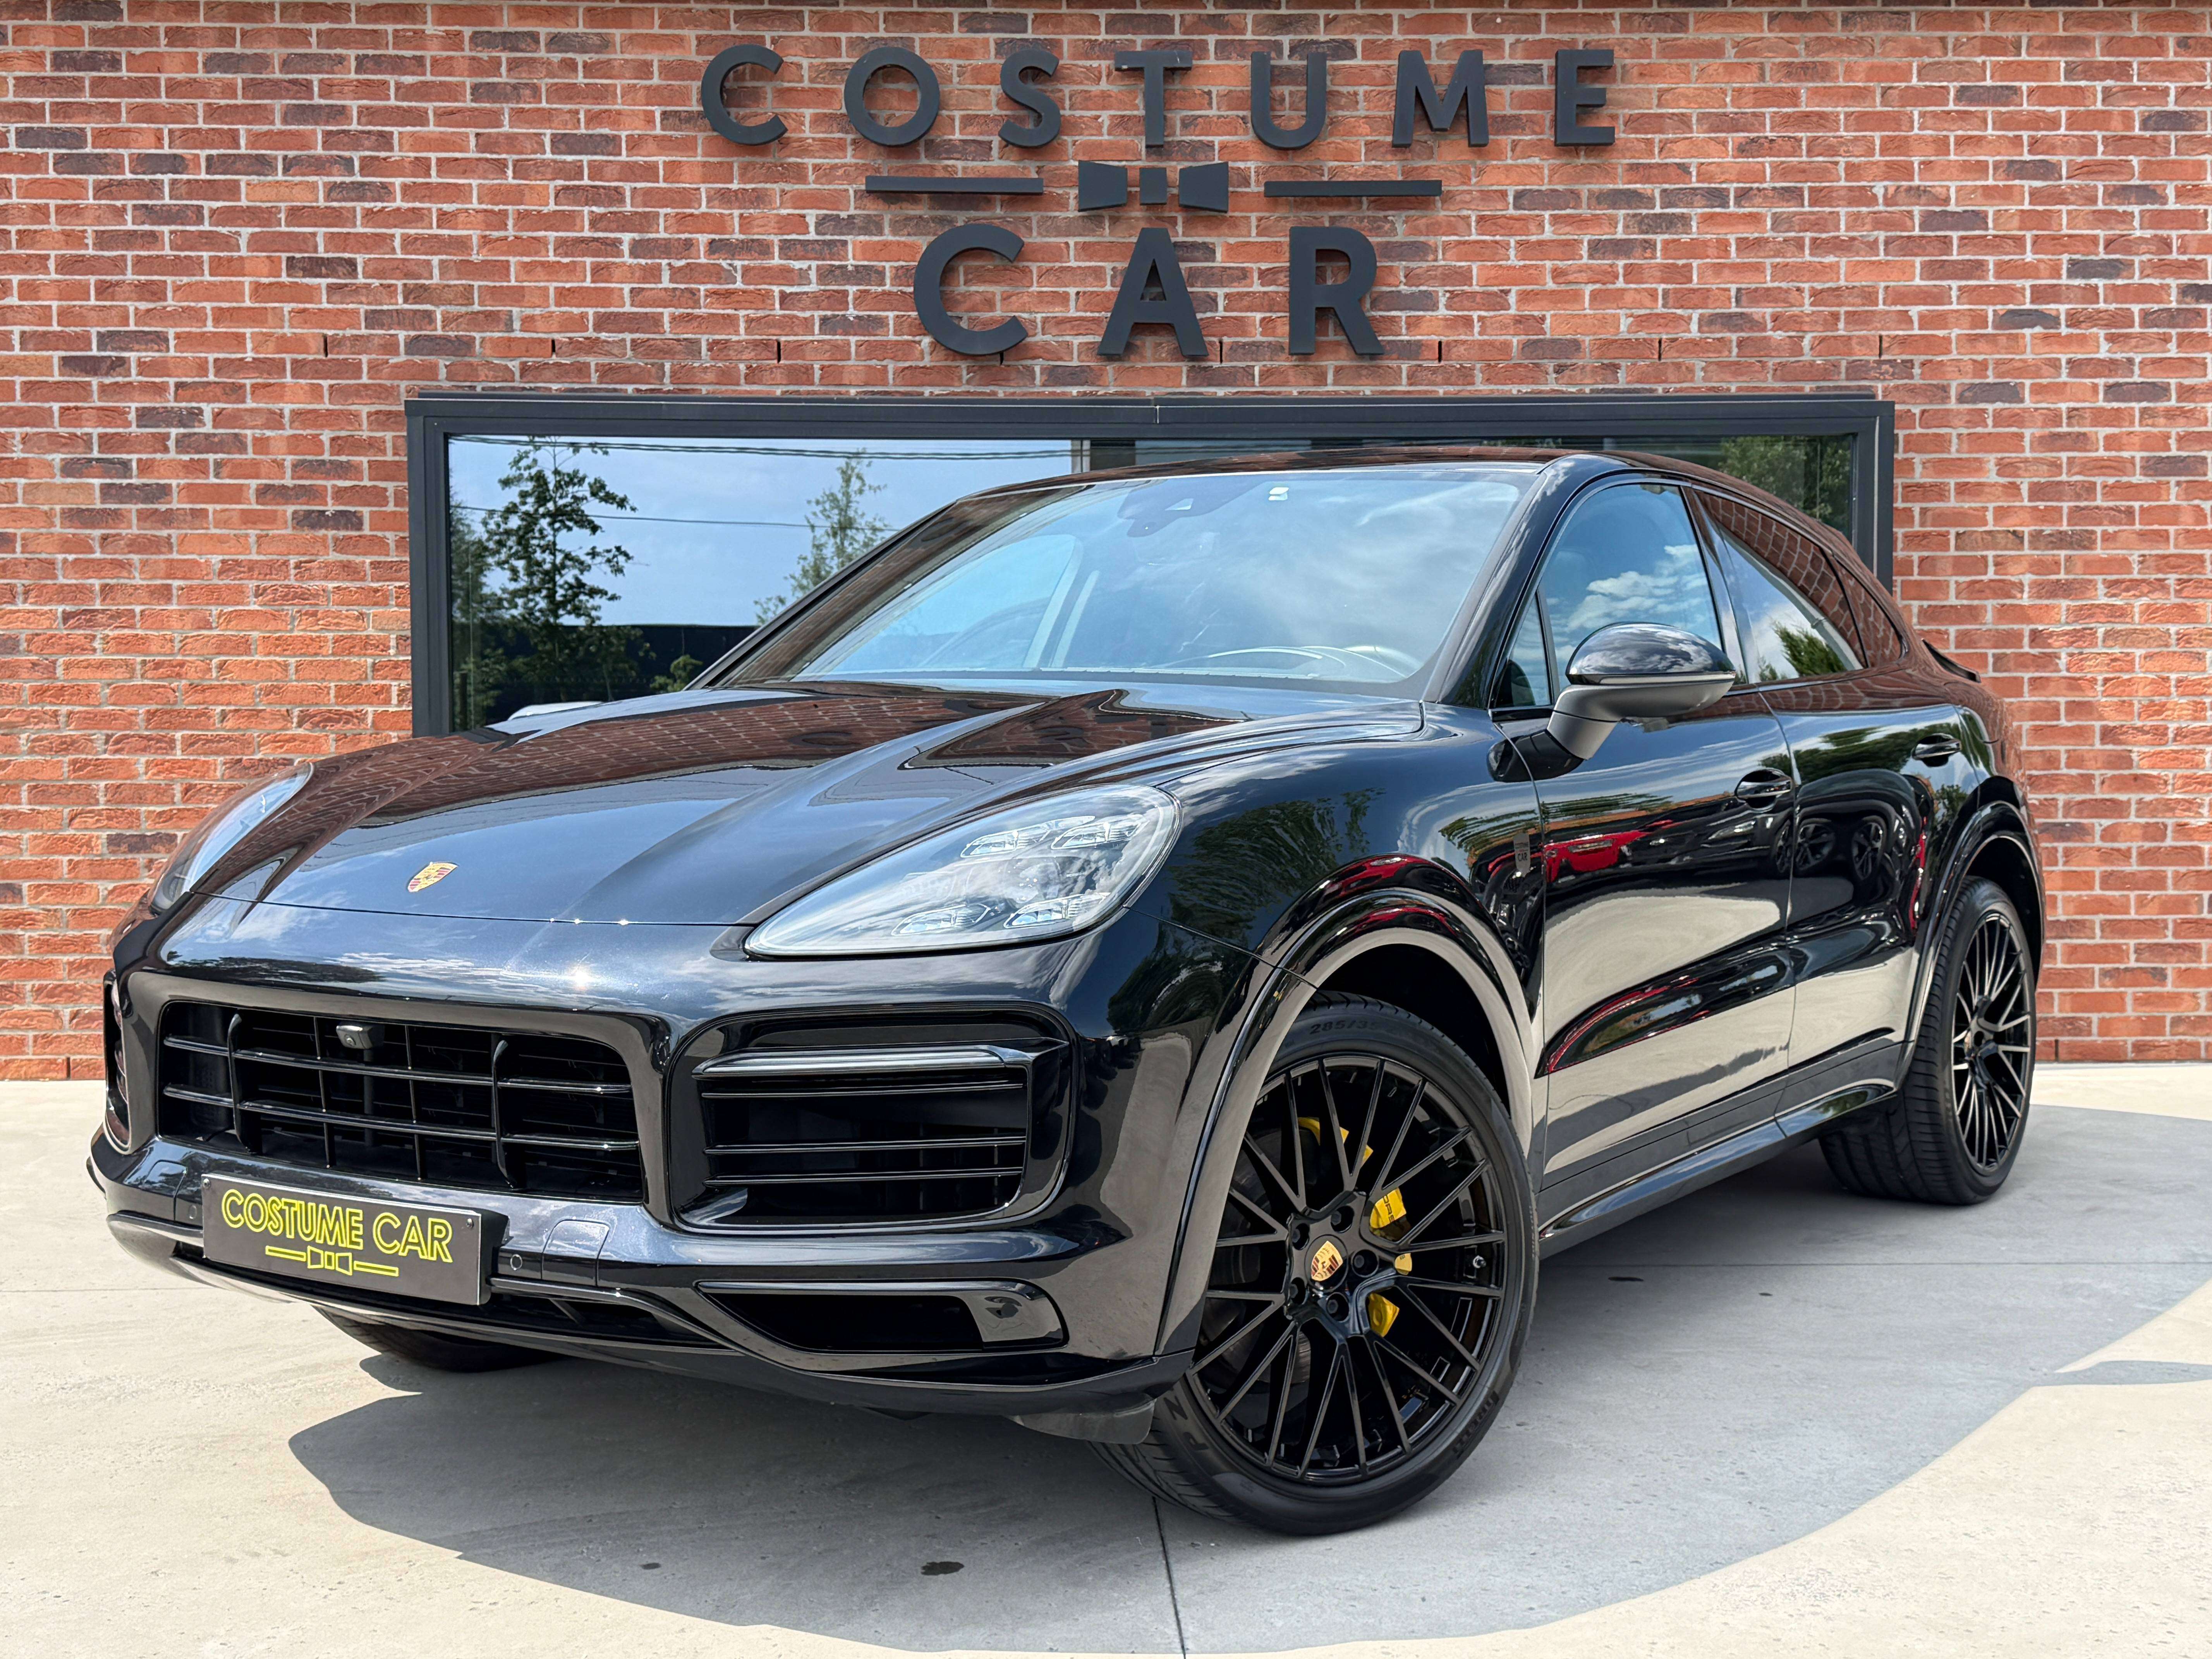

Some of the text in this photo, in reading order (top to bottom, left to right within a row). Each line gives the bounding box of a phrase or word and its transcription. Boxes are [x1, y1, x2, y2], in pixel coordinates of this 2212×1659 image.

[700, 43, 1615, 149] COSTUME
[913, 223, 1384, 357] CAR
[222, 1189, 453, 1263] COSTUME CAR
